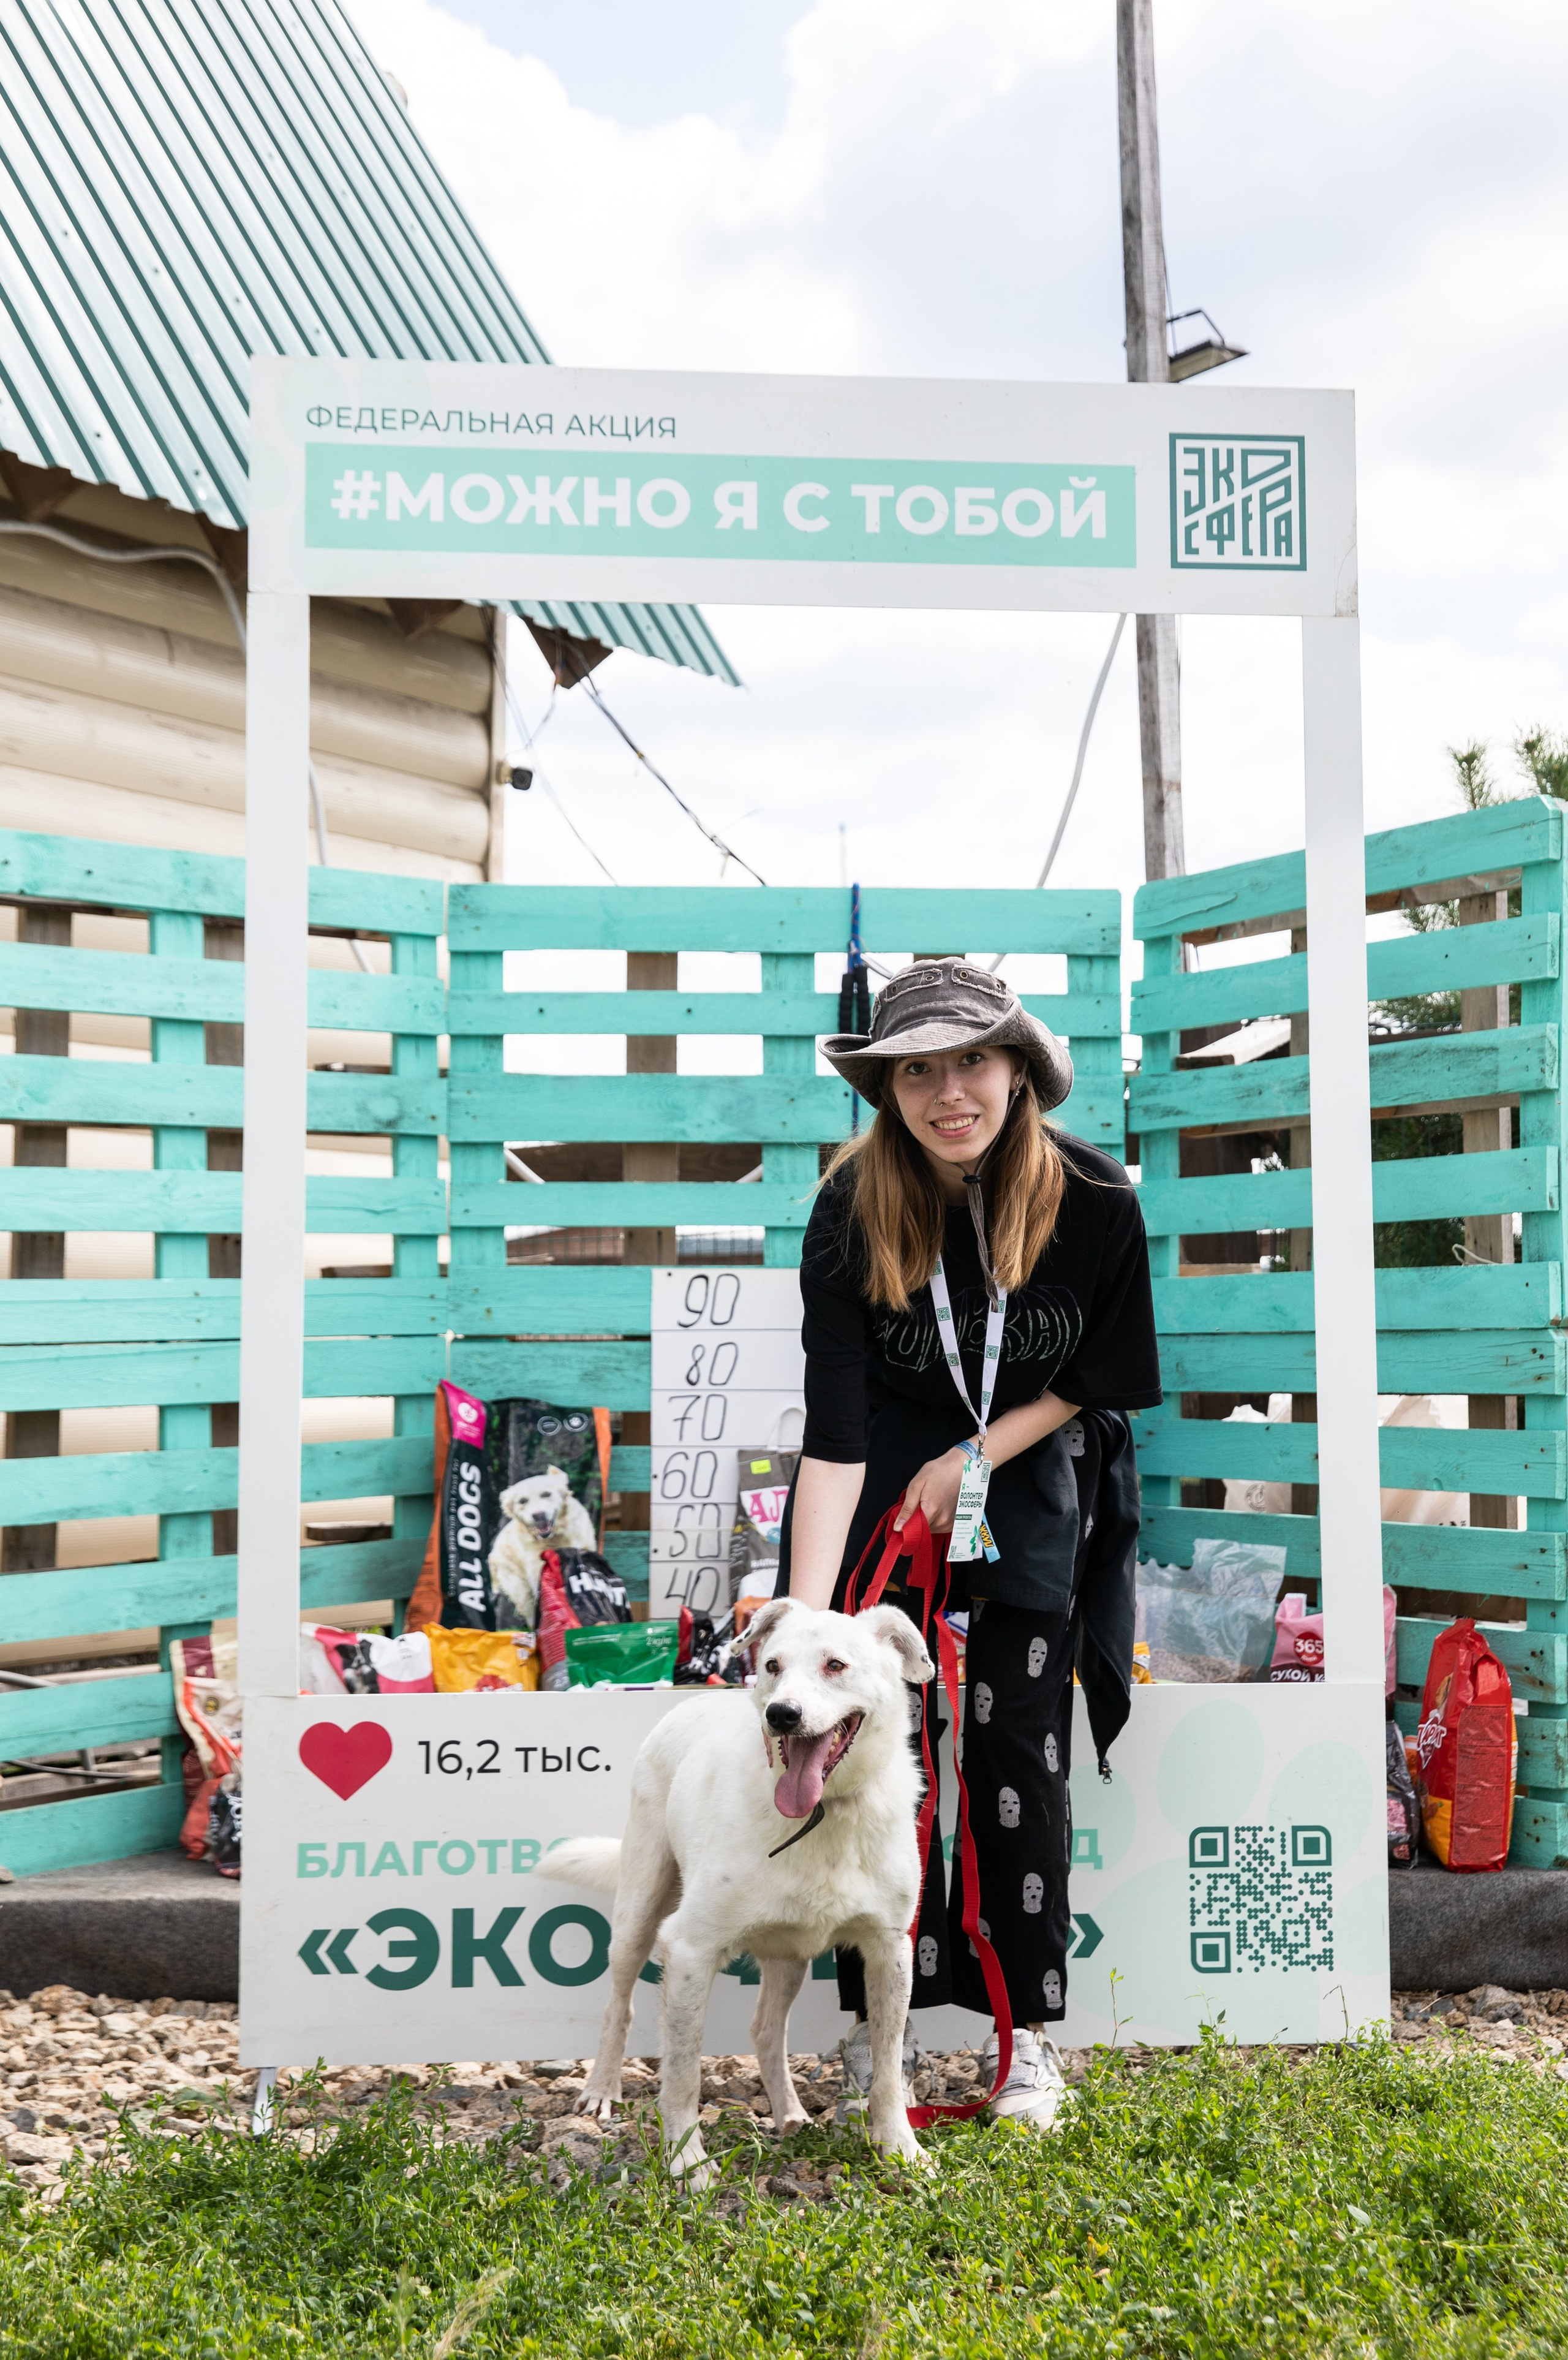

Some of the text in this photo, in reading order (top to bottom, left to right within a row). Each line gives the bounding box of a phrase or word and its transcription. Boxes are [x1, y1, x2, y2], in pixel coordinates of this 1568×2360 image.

[306, 405, 677, 441] ФЕДЕРАЛЬНАЯ АКЦИЯ
[331, 469, 1106, 539] #МОЖНО Я С ТОБОЙ
[677, 1273, 740, 1328] 90
[685, 1342, 739, 1386] 80
[668, 1394, 727, 1442] 70
[661, 1451, 718, 1499] 60
[457, 1461, 482, 1551] DOGS
[669, 1503, 722, 1558] 50
[458, 1557, 486, 1613] ALL
[665, 1566, 720, 1613] 40
[1295, 1638, 1324, 1654] 365
[1270, 1668, 1311, 1682] СУХОЙ
[418, 1739, 612, 1780] 16,2 тыс.
[296, 1837, 571, 1878] БЛАГОТВ
[296, 1904, 612, 1991] «ЭКО
